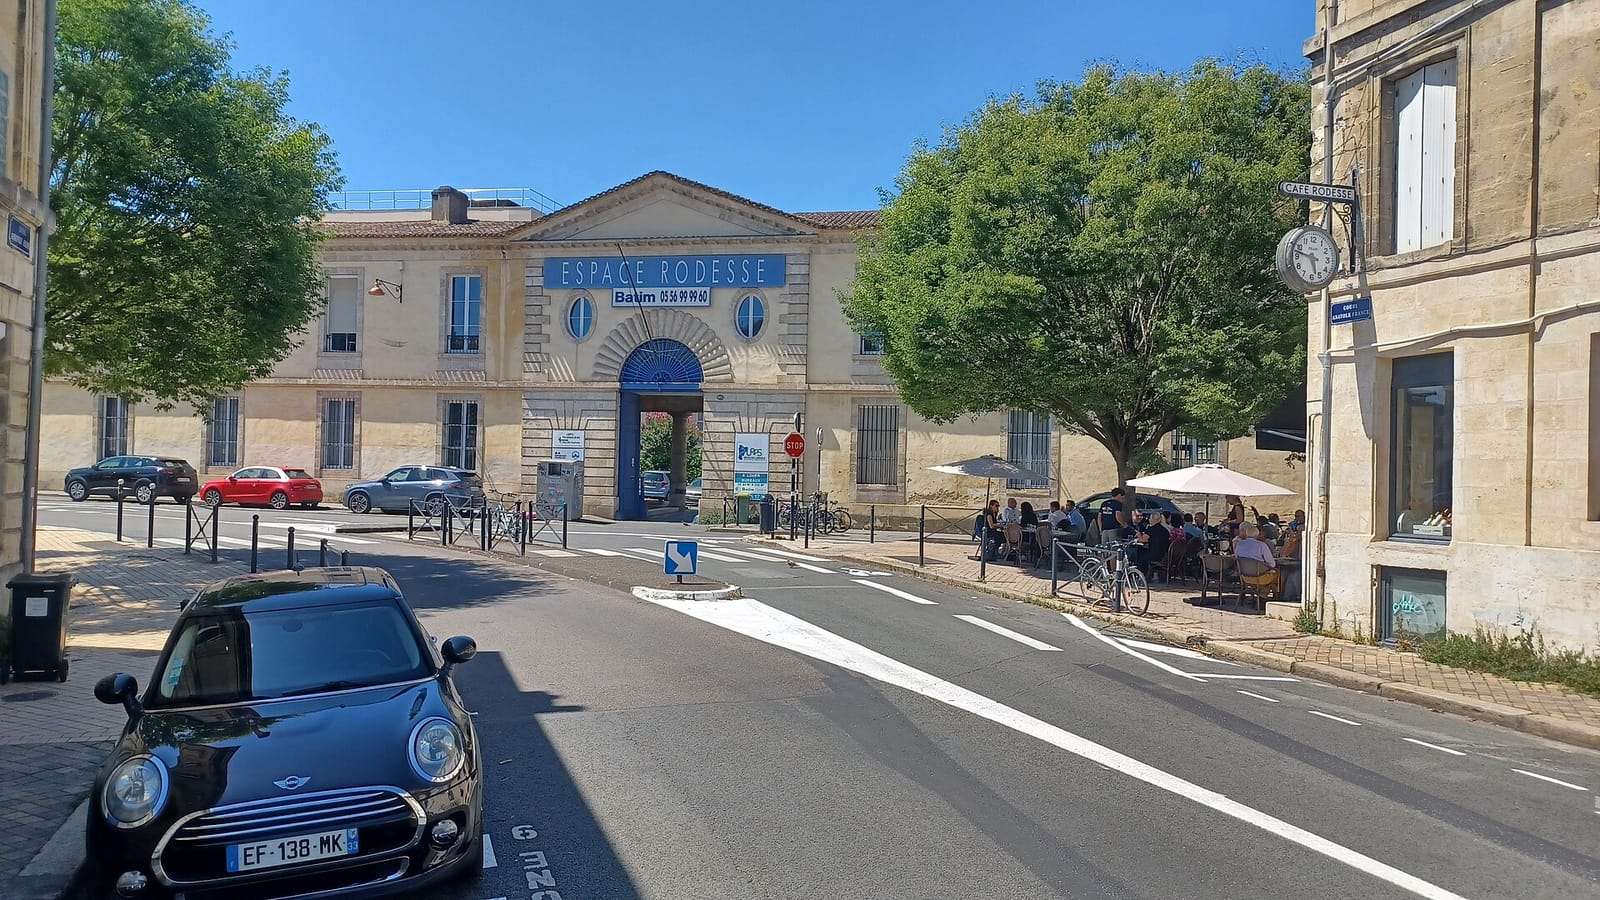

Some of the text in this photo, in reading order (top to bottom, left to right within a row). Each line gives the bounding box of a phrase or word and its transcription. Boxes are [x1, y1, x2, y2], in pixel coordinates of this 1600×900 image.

[1285, 183, 1353, 199] CAFE RODESSE
[1303, 237, 1308, 245] 11
[1323, 247, 1328, 255] 2
[562, 259, 765, 285] ESPACE RODESSE
[615, 290, 708, 303] Batim 05 56 99 99 60
[786, 441, 804, 449] STOP
[243, 833, 343, 866] EF-138-MK
[347, 841, 359, 851] 33
